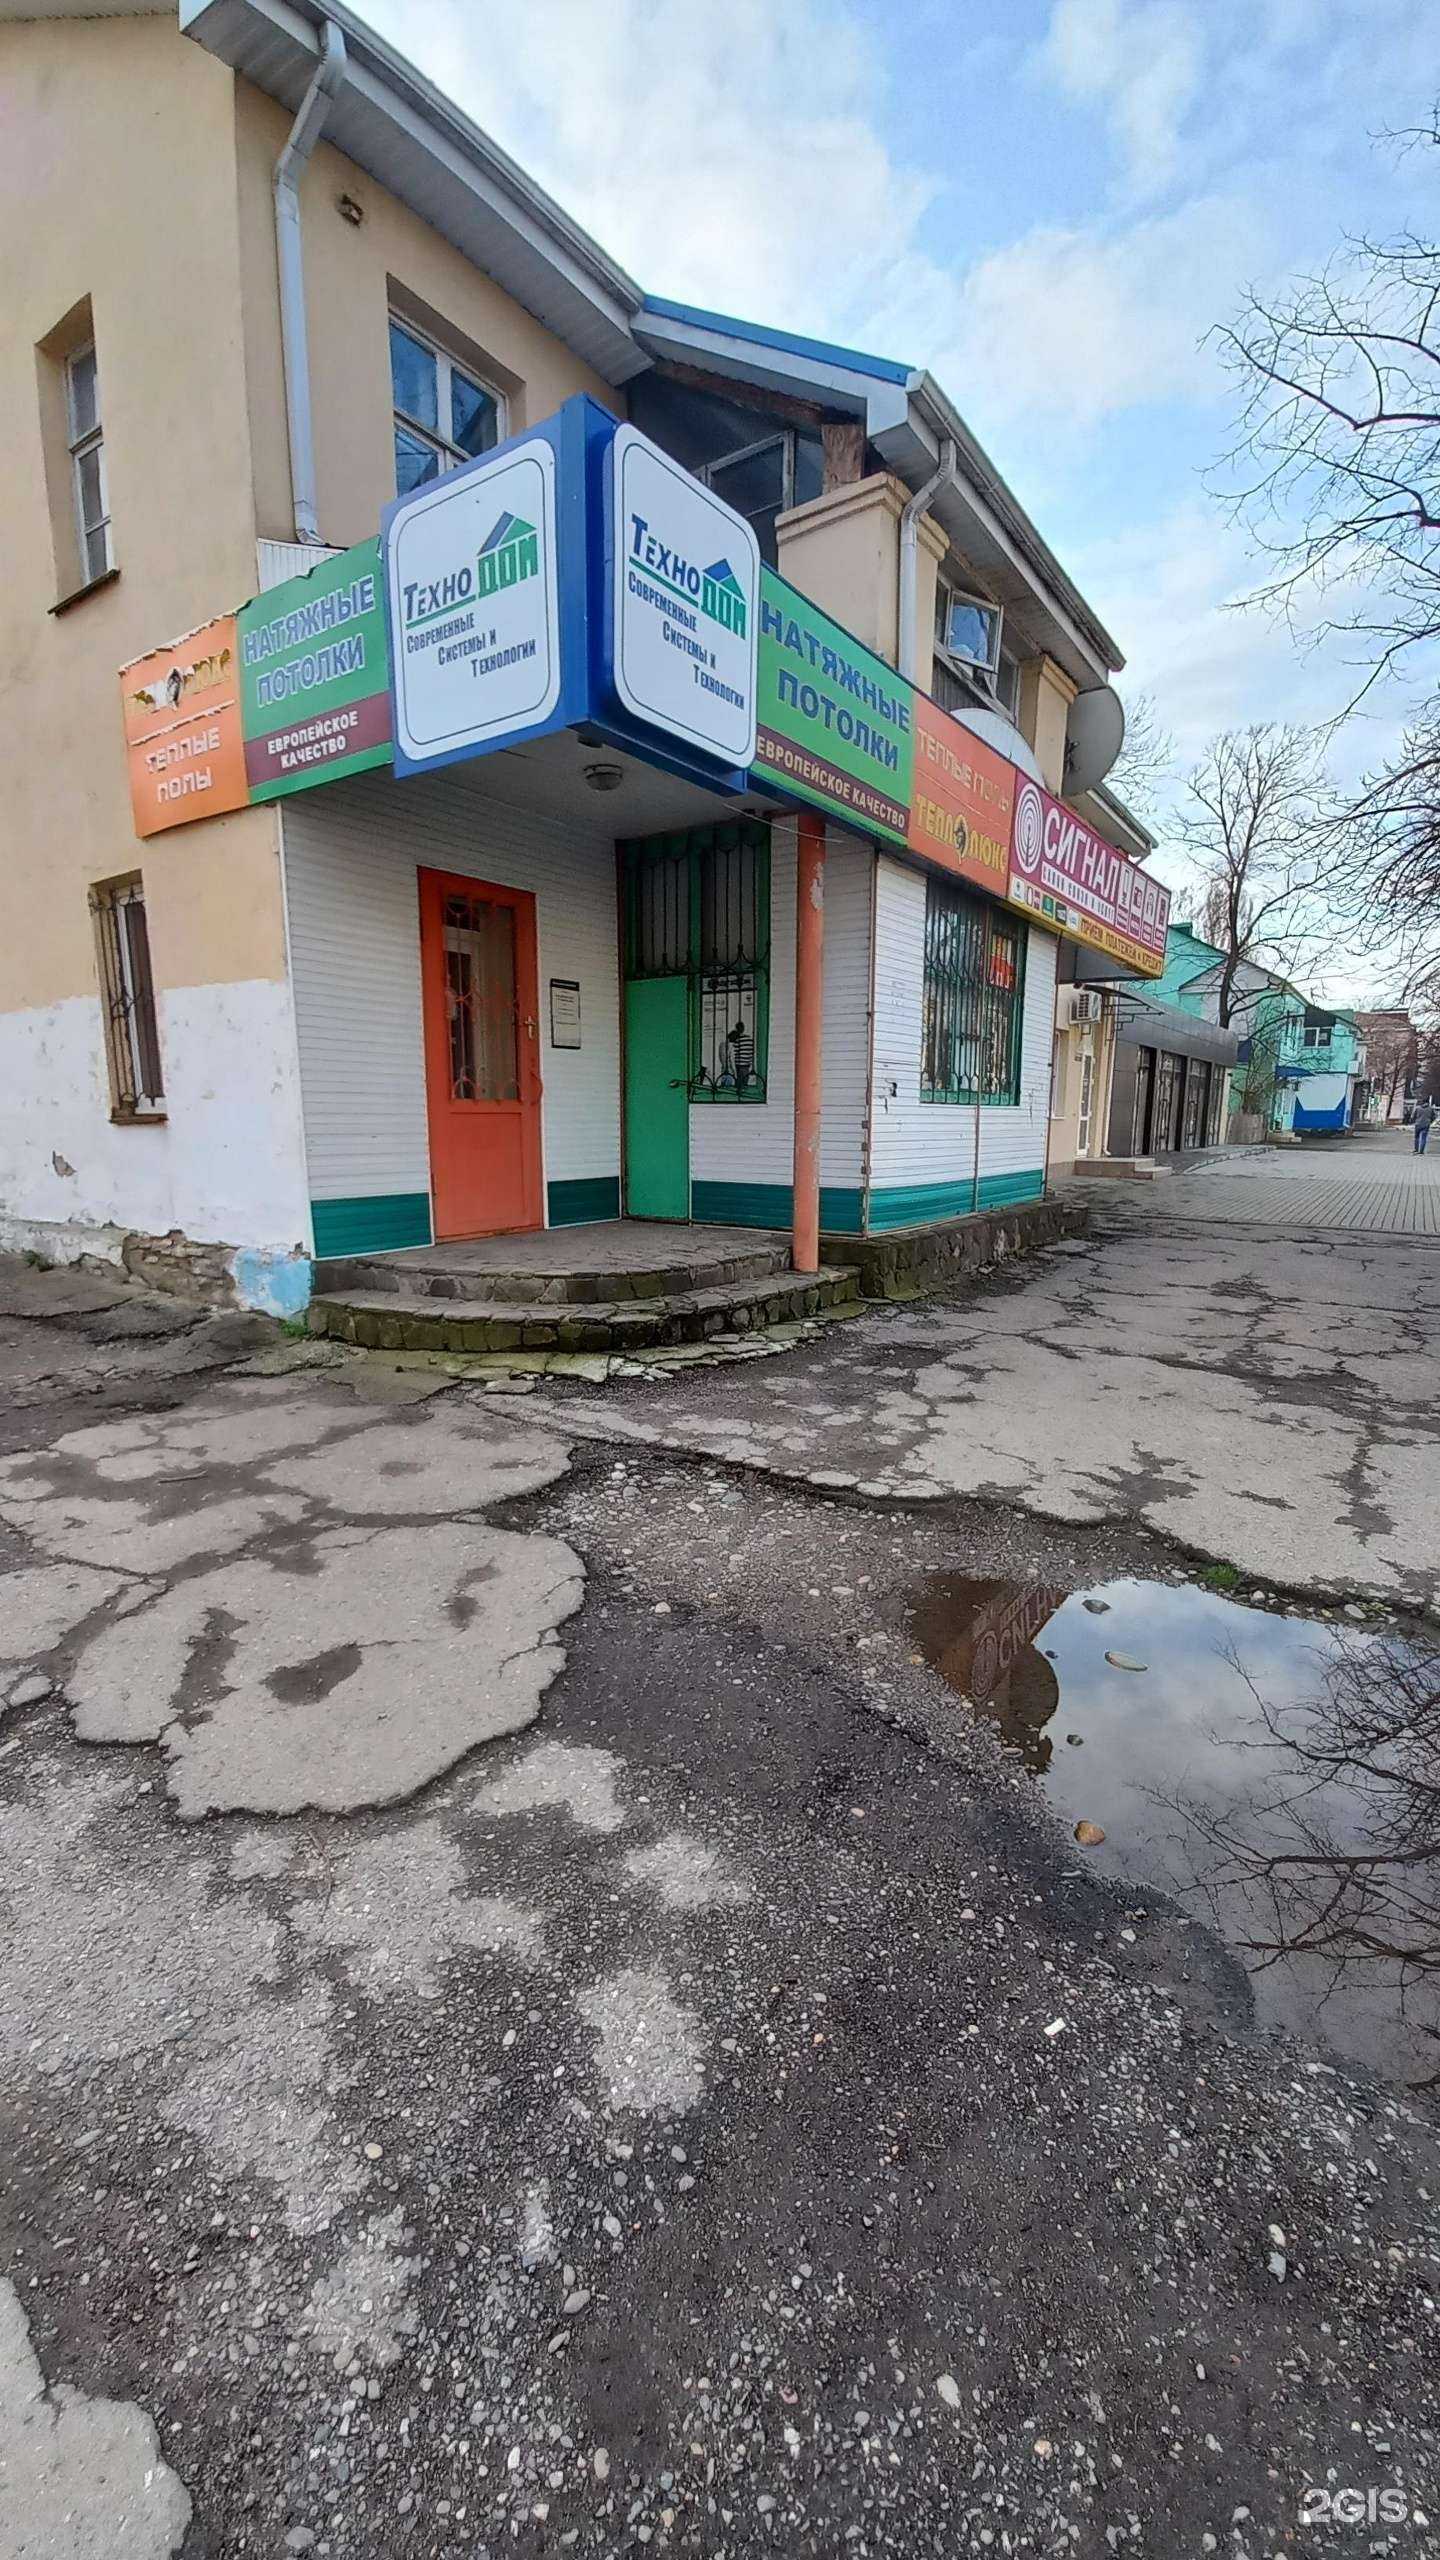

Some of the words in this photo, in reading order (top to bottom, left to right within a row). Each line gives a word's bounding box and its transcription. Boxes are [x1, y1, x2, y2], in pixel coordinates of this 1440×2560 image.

[478, 533, 538, 599] ДОМ
[243, 574, 376, 666] НАТЯЖНЫЕ
[702, 573, 746, 640] ДОМ
[256, 633, 366, 708] ПОТОЛКИ
[762, 600, 910, 734] НАТЯЖНЫЕ
[145, 727, 222, 775] ТЕПЛЫЕ
[267, 710, 359, 755] ЕВРОПЕЙСКОЕ
[280, 734, 347, 769] КАЧЕСТВО
[777, 667, 899, 772] ПОТОЛКИ
[157, 766, 213, 804] ПОЛЫ
[756, 735, 852, 799] ЕВРОПЕЙСКОЕ
[852, 786, 906, 830] КАЧЕСТВО
[1044, 807, 1121, 903] СИГНАЛ
